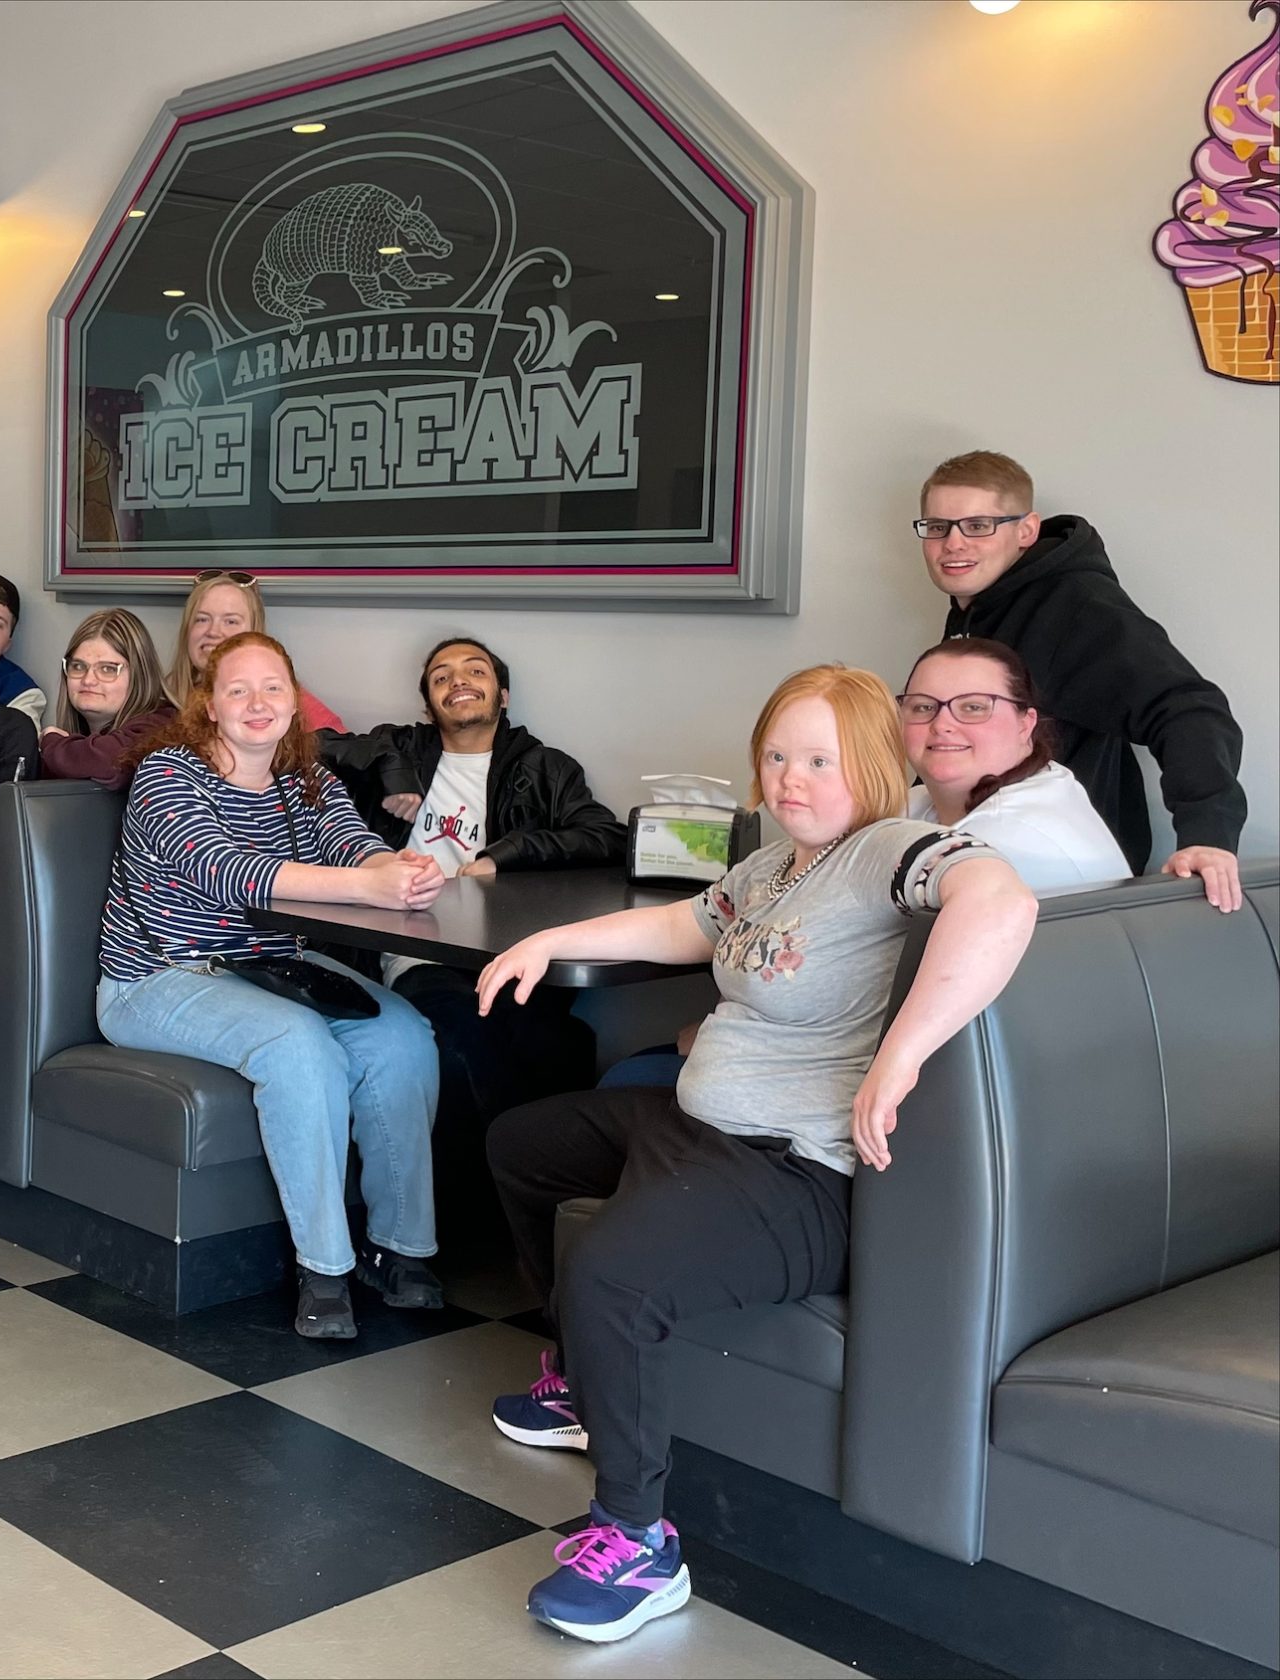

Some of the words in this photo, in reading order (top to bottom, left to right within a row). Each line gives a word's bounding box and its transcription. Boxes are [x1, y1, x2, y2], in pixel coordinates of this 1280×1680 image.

[232, 322, 475, 387] ARMADILLOS
[120, 402, 252, 509] ICE
[270, 363, 642, 502] CREAM
